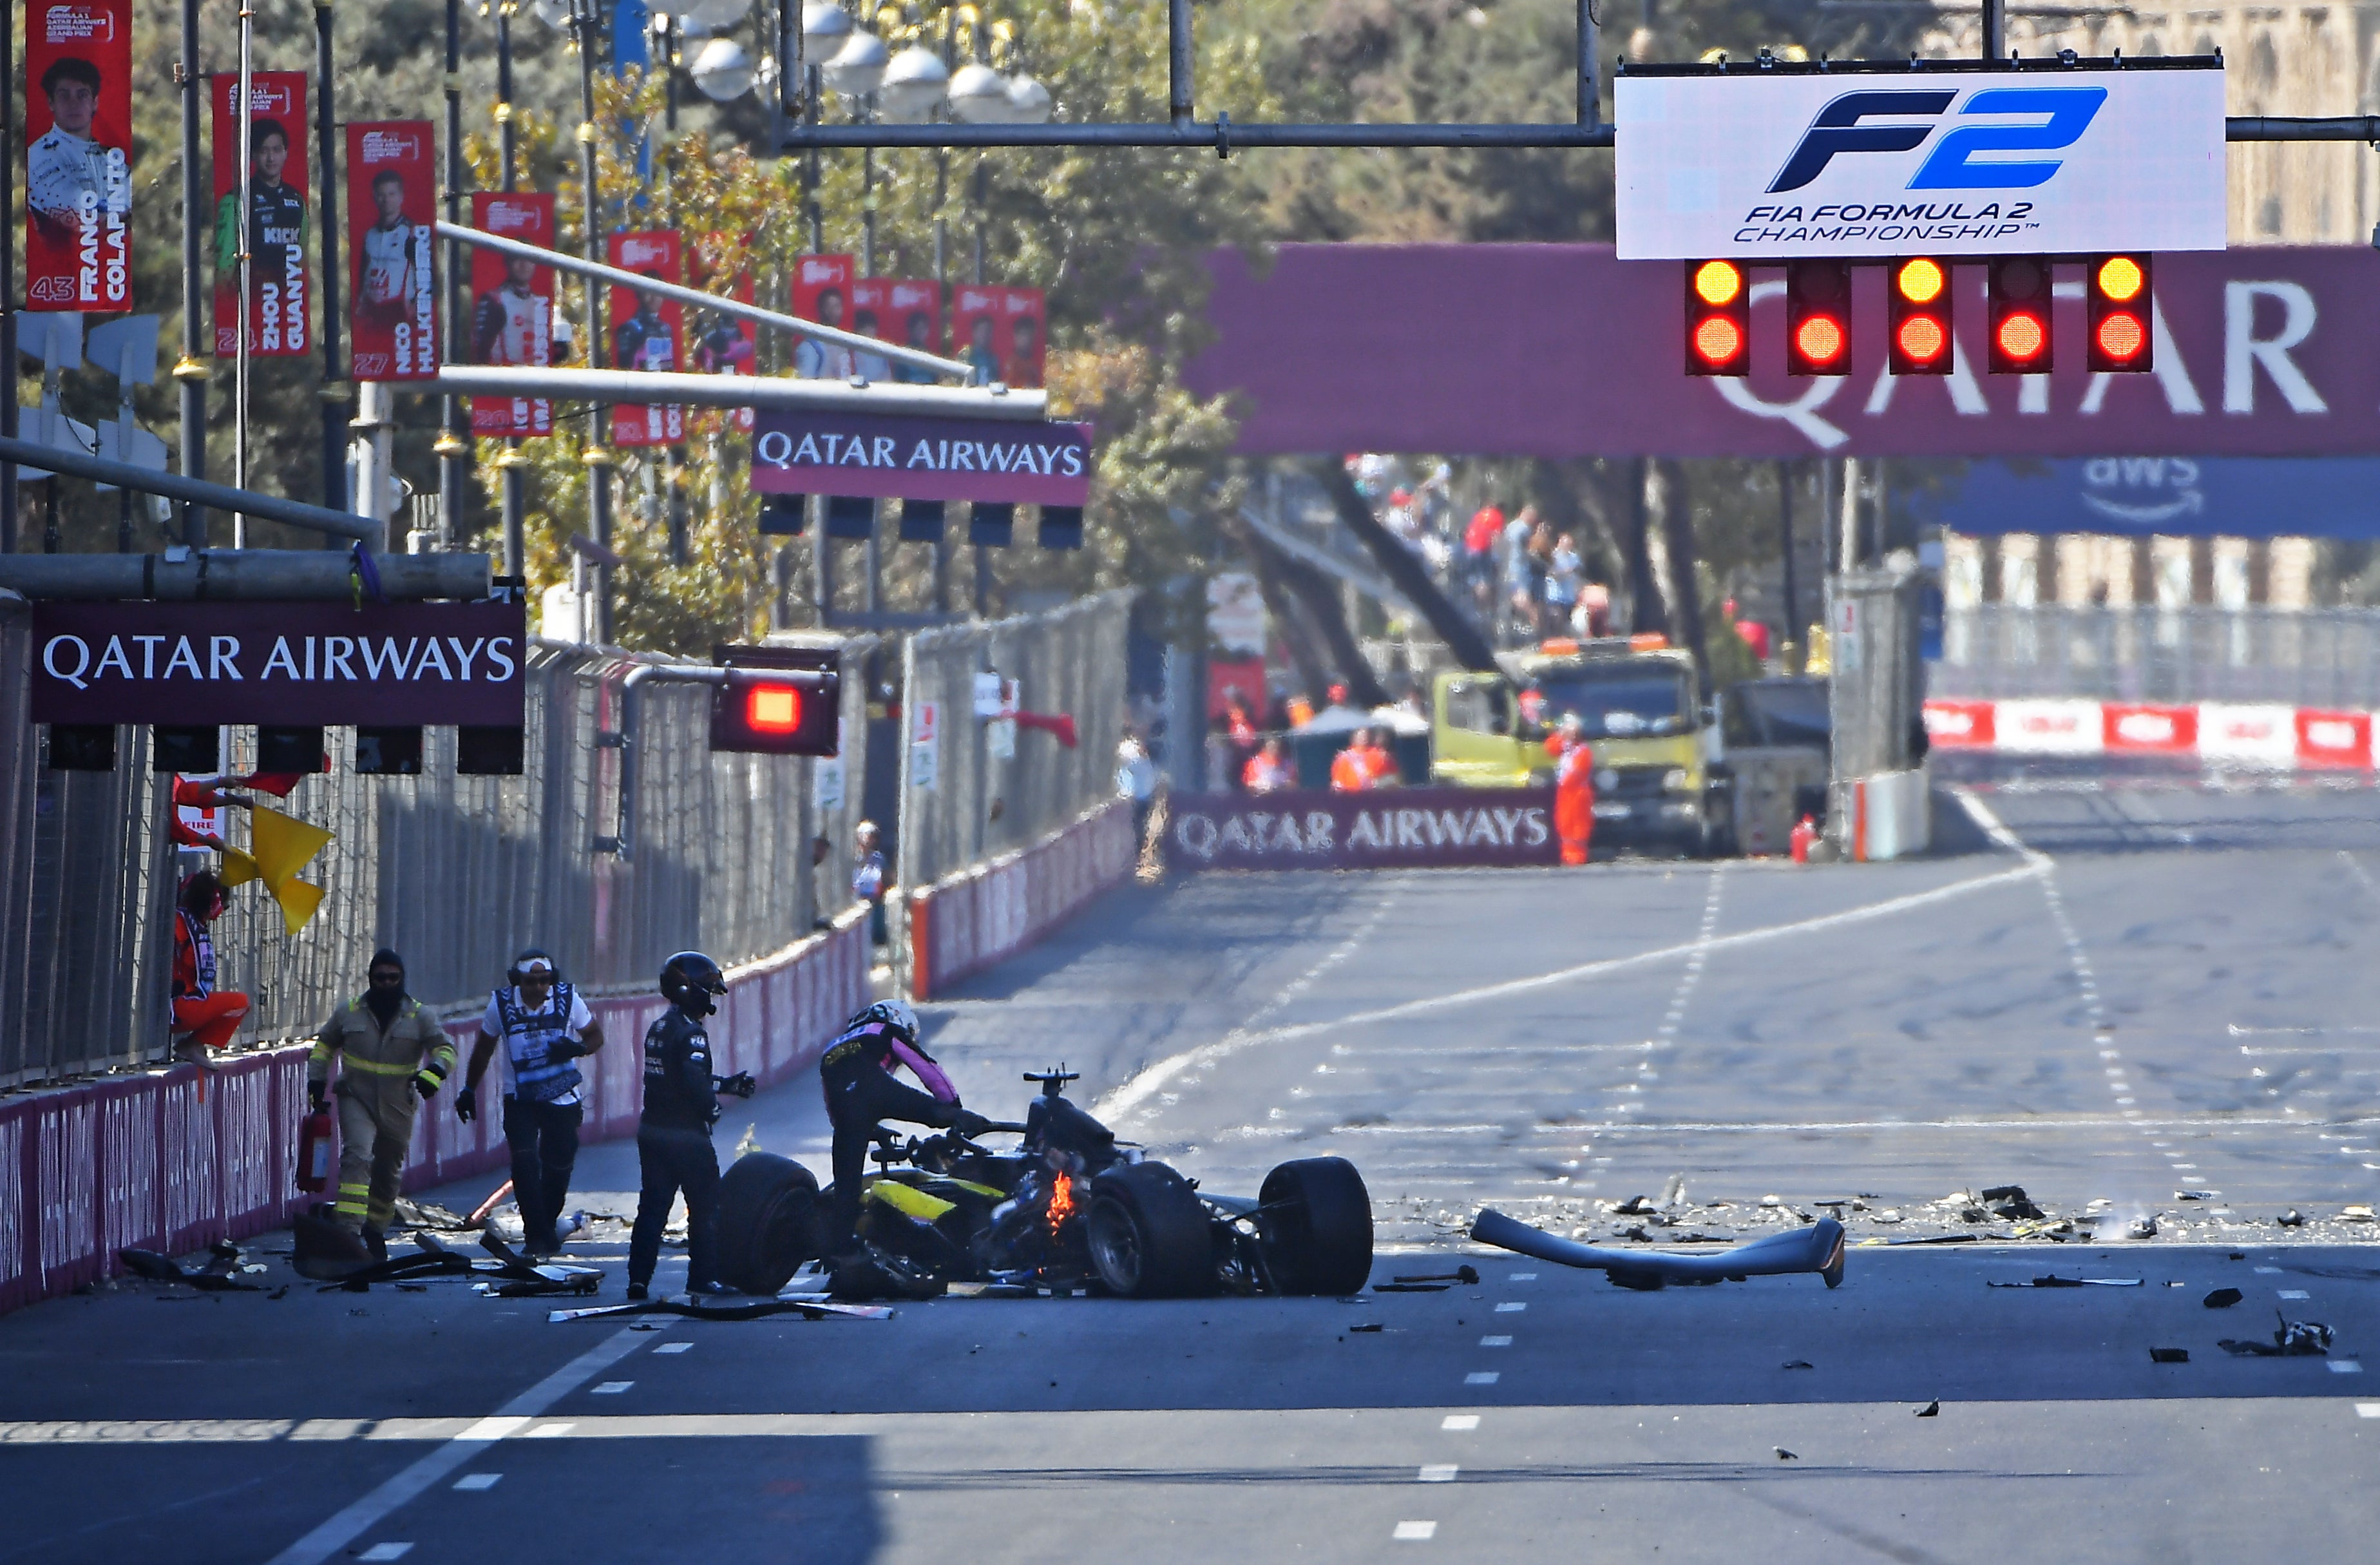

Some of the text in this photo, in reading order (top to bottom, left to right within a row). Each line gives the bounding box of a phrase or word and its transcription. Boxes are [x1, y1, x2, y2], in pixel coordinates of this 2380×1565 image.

[1764, 86, 2108, 193] F2
[106, 147, 126, 302] COLAPINTO
[263, 227, 300, 244] KICK
[1745, 202, 2033, 223] FIA FORMULA 2
[79, 190, 99, 301] FRANCO
[30, 276, 75, 302] 43
[286, 244, 304, 350] GUANYU
[262, 282, 280, 350] ZHOU
[354, 353, 388, 376] 27
[395, 322, 412, 374] NICO
[757, 430, 1082, 477] QATAR AIRWAYS
[2084, 458, 2200, 486] aws
[43, 634, 515, 689] QATAR AIRWAYS
[1176, 806, 1548, 860] QATAR AIRWAYS
